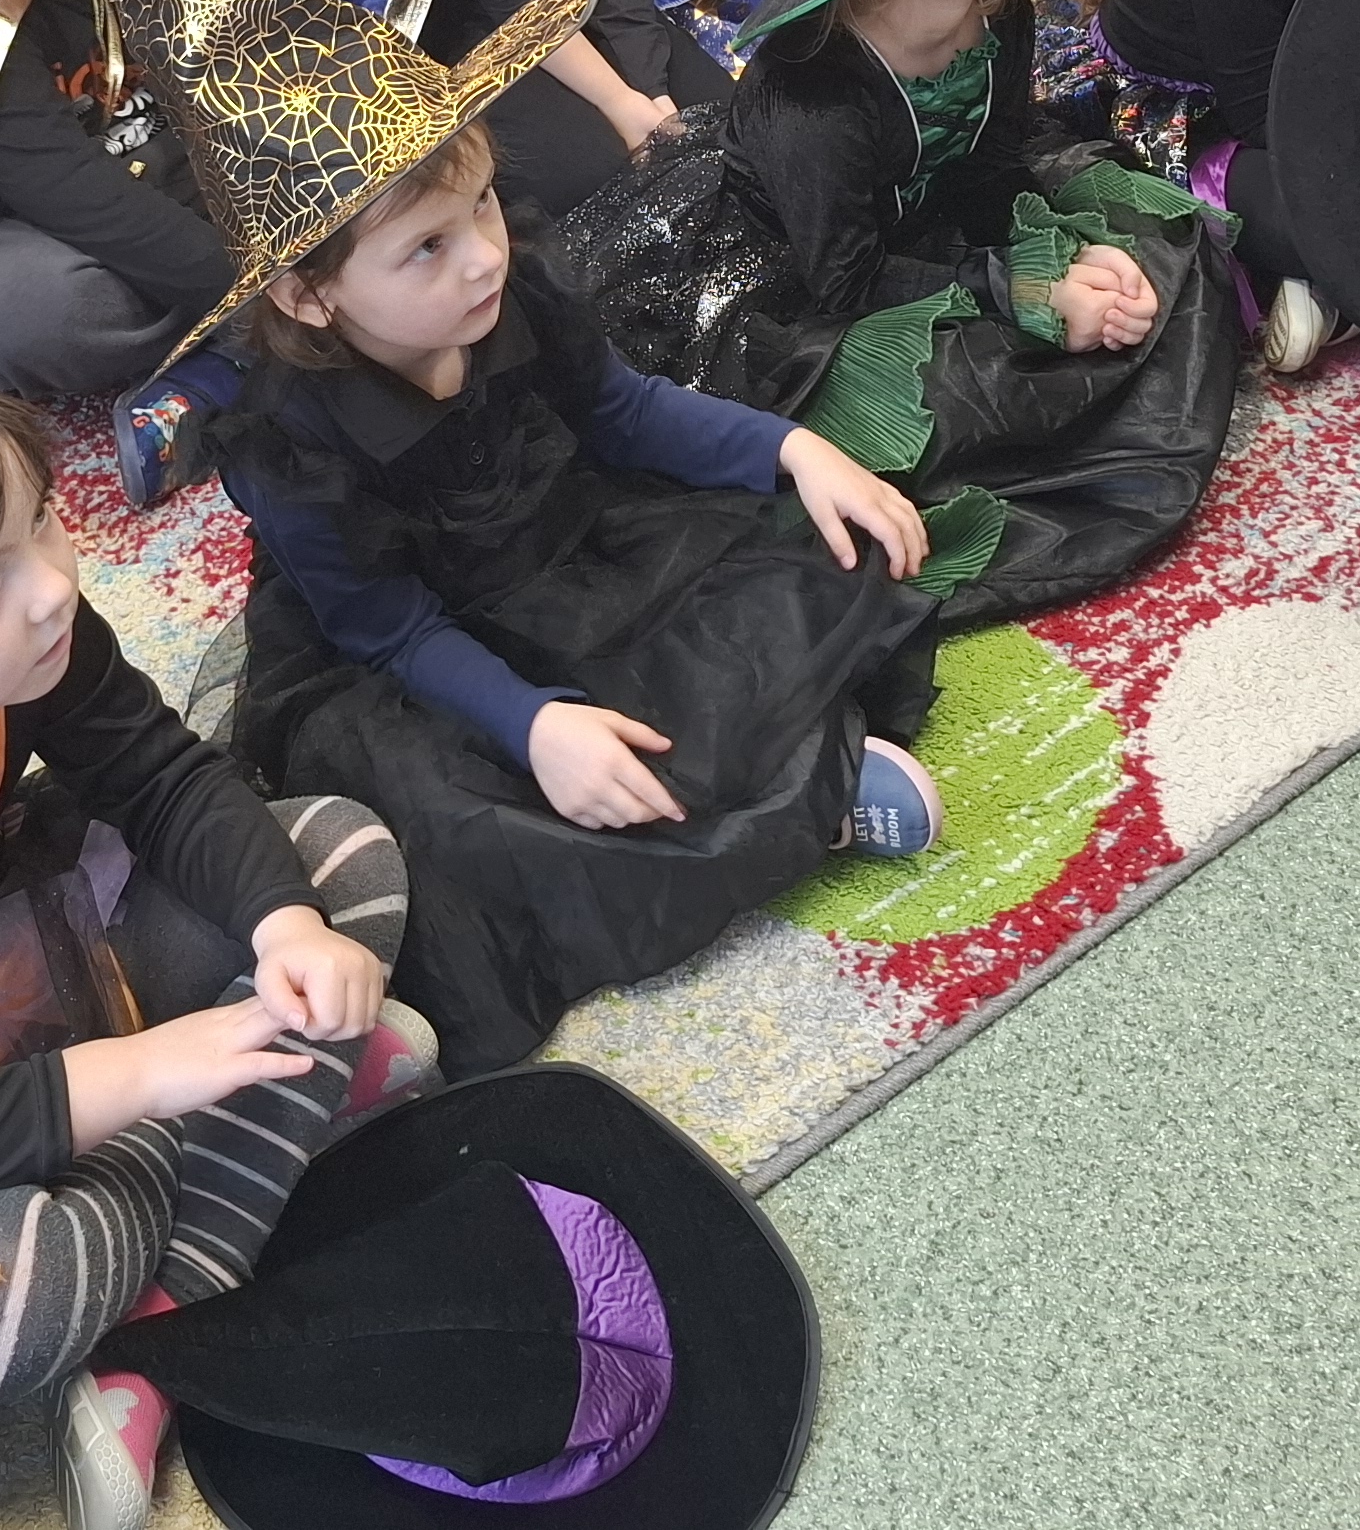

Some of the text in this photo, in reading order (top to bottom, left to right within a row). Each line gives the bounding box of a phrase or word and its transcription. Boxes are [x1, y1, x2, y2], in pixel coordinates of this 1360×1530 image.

[853, 805, 869, 842] LET IT
[886, 807, 902, 848] BLOOM
